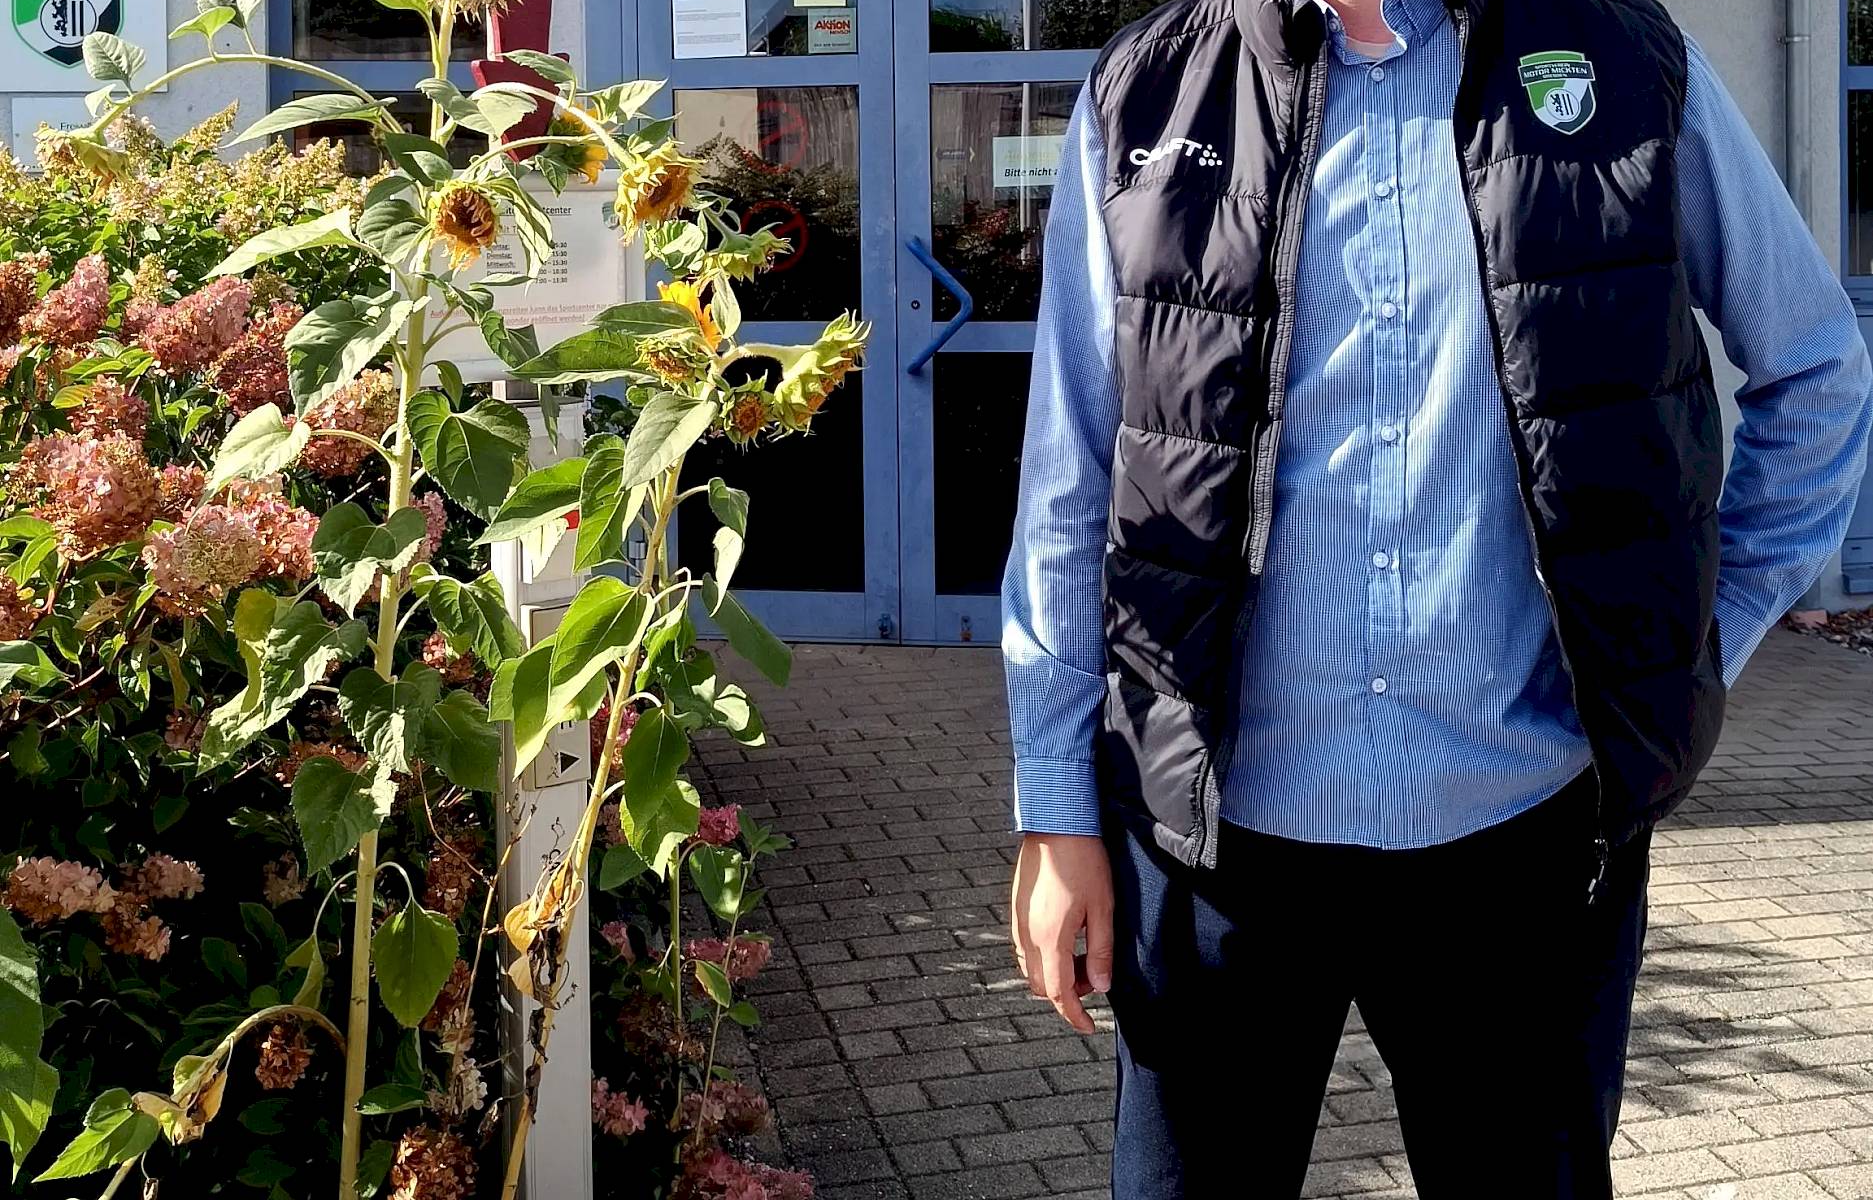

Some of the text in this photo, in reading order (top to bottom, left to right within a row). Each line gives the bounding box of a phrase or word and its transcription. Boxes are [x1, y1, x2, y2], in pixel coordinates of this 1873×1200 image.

[1523, 67, 1550, 78] MOTOR
[1004, 167, 1027, 177] Bitte
[1028, 167, 1052, 177] nicht
